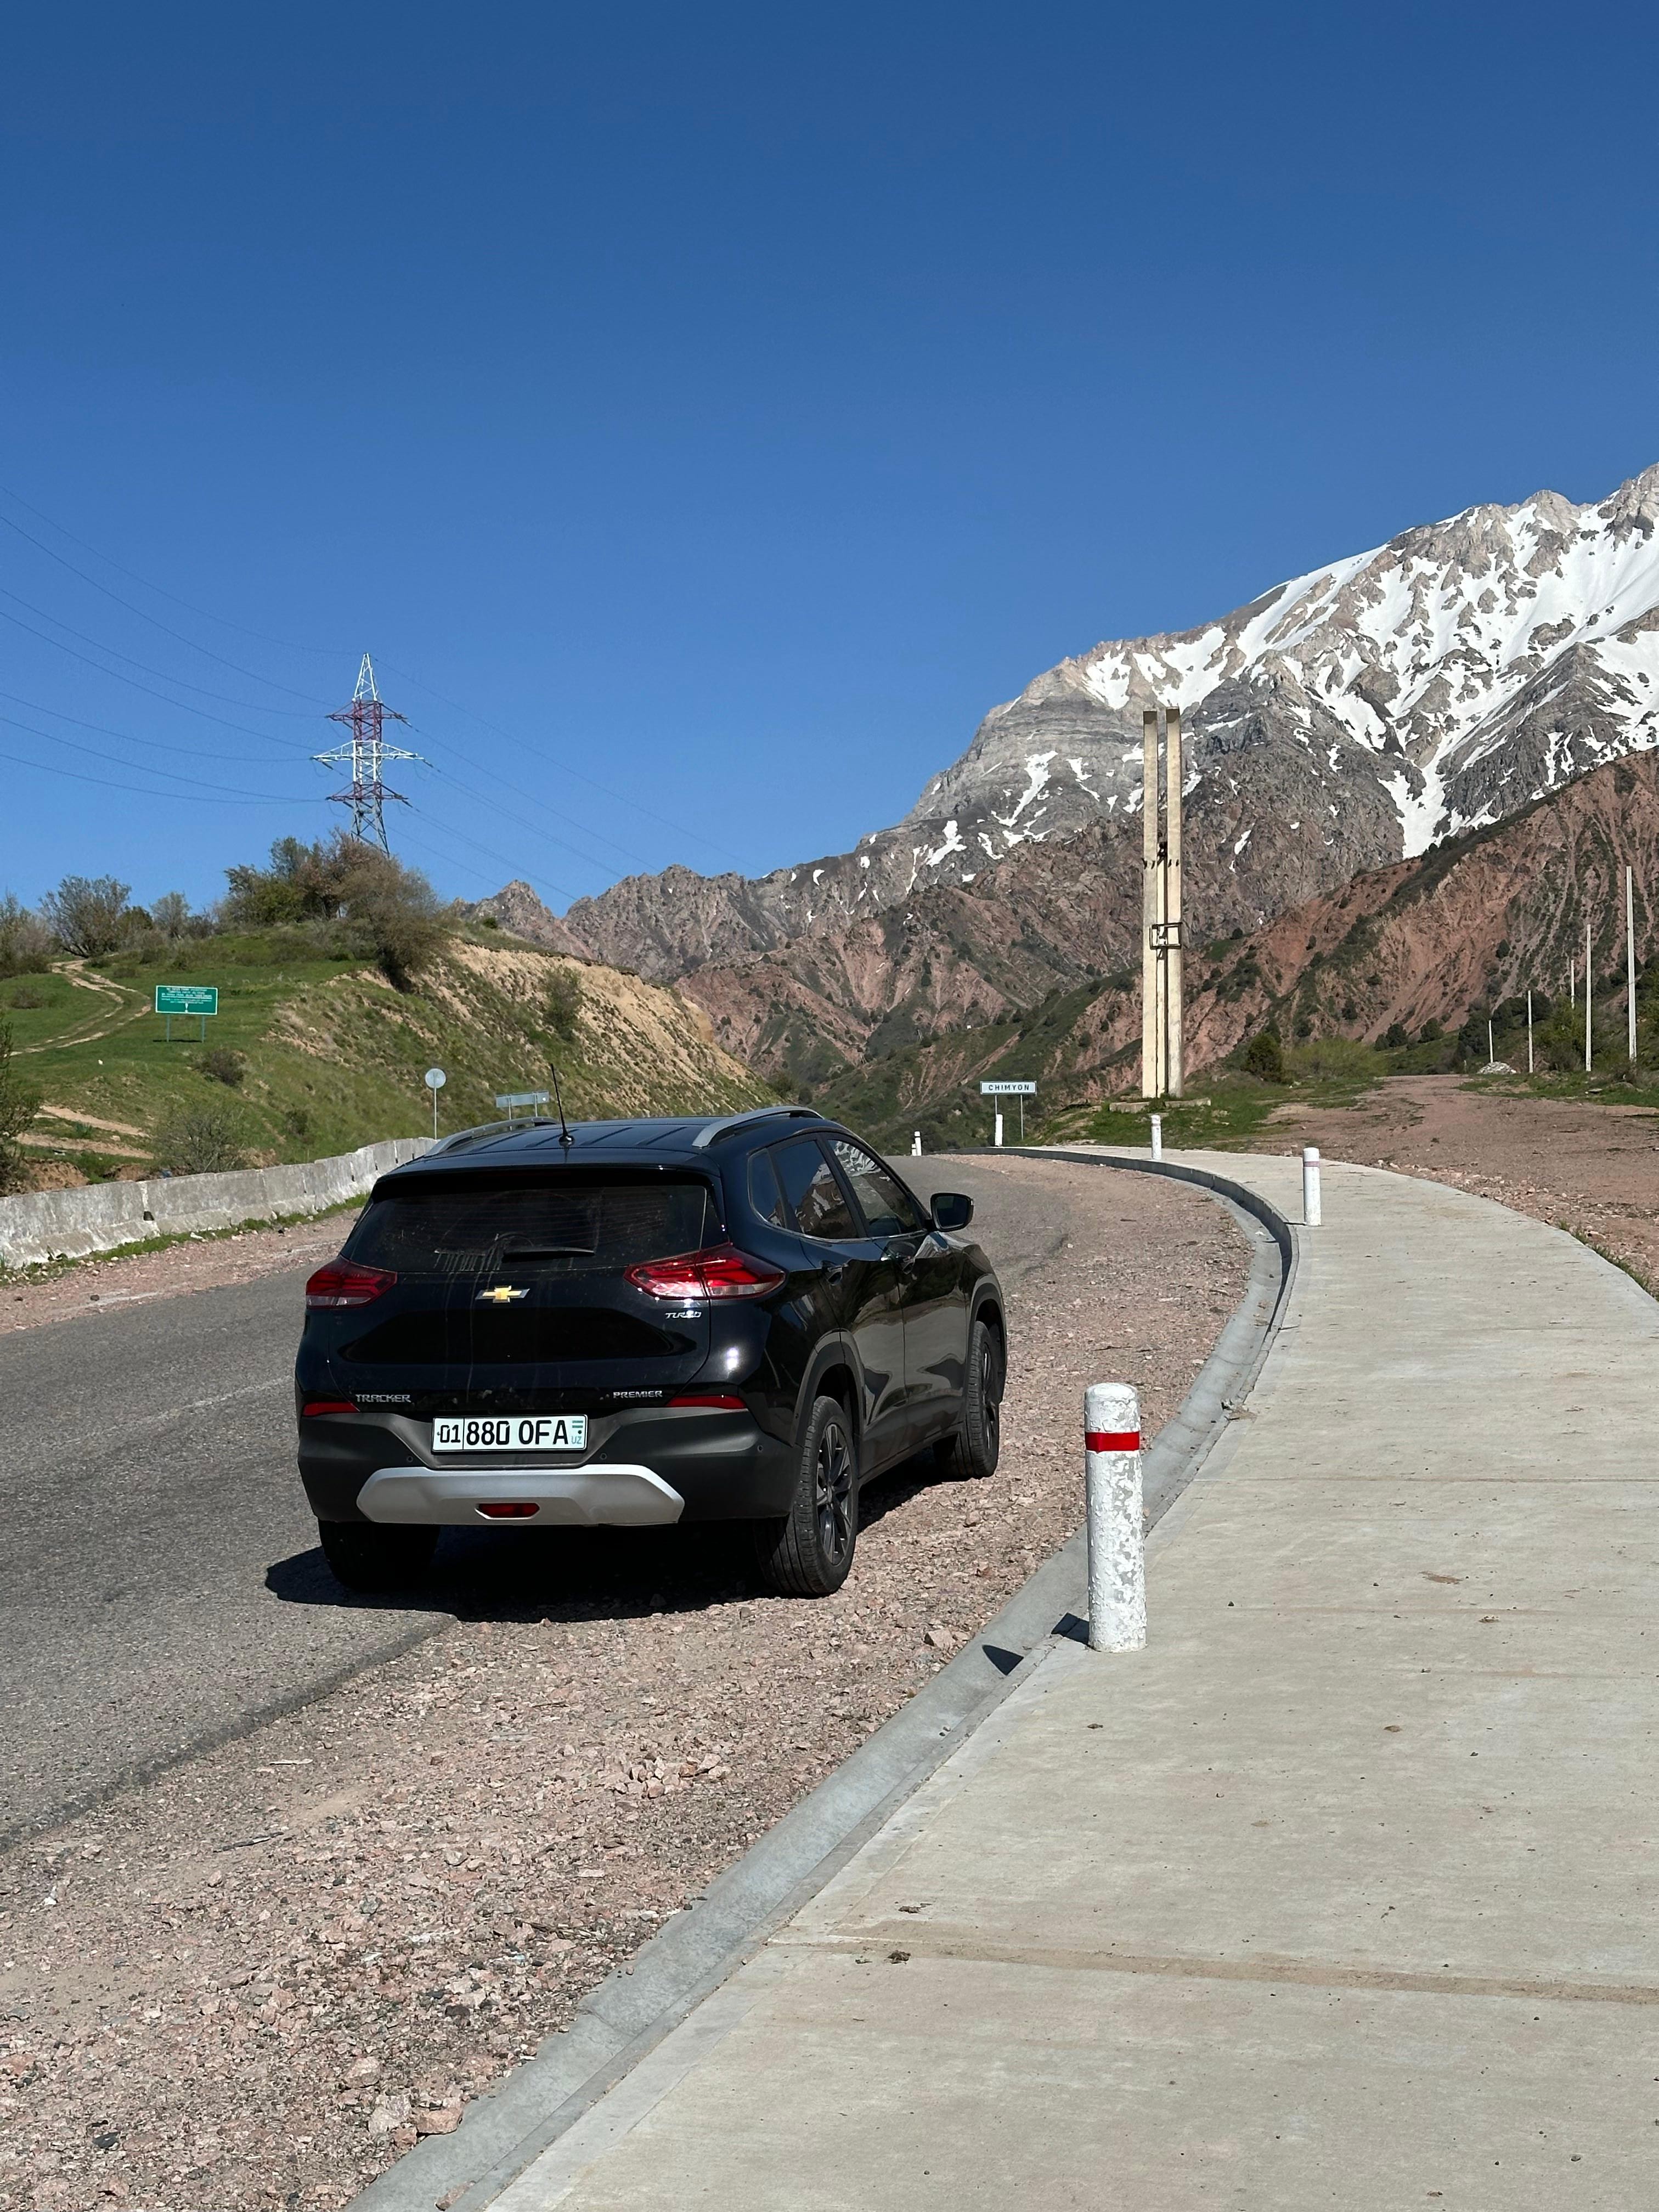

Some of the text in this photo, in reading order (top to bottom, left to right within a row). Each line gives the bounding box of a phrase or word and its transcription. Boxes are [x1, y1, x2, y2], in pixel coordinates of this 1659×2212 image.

[356, 1394, 411, 1402] TRACKER
[440, 1420, 568, 1445] 01 880 OFA
